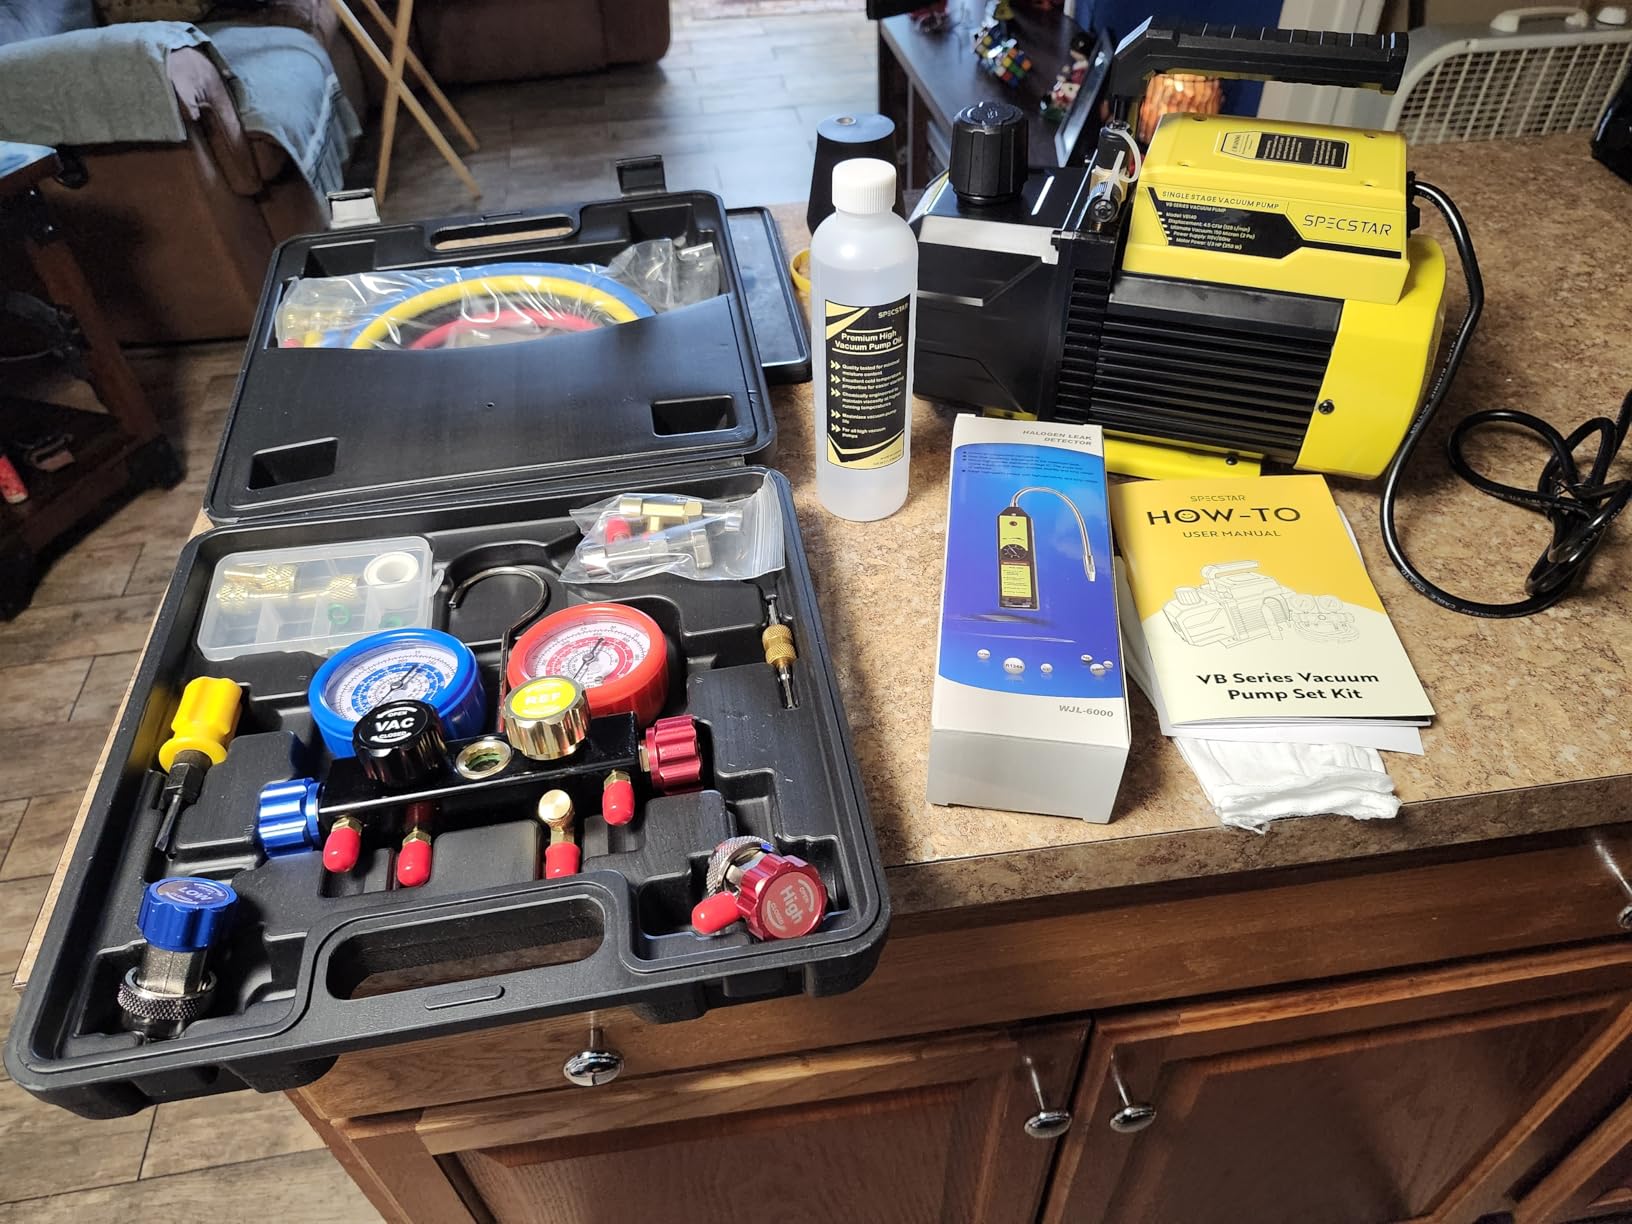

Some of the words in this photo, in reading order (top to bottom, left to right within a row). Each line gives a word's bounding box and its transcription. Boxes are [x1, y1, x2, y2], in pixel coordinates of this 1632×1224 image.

[1163, 191, 1190, 199] SINGLE
[1191, 194, 1216, 202] STAGE
[1218, 197, 1254, 206] VACUUM
[1256, 201, 1280, 209] PUMP
[1302, 214, 1392, 236] SPECSTAR
[878, 302, 909, 318] SPECSTAR
[835, 340, 867, 351] Vacuum
[869, 341, 891, 351] Pump
[893, 336, 902, 345] Oil
[841, 333, 877, 342] Premium
[879, 330, 896, 340] High
[1023, 430, 1065, 438] HALOGEN
[1147, 507, 1301, 525] HOW-TO
[1196, 673, 1228, 685] VB
[1232, 672, 1294, 683] Series
[1297, 672, 1380, 682] Vacuum
[525, 691, 561, 706] REF
[1228, 688, 1288, 701] Pump
[1292, 688, 1327, 699] Set
[1331, 688, 1363, 699] Kit
[1059, 704, 1114, 718] WJL-6000
[375, 717, 415, 732] VAC
[379, 731, 407, 739] CLOSED
[780, 885, 804, 924] High
